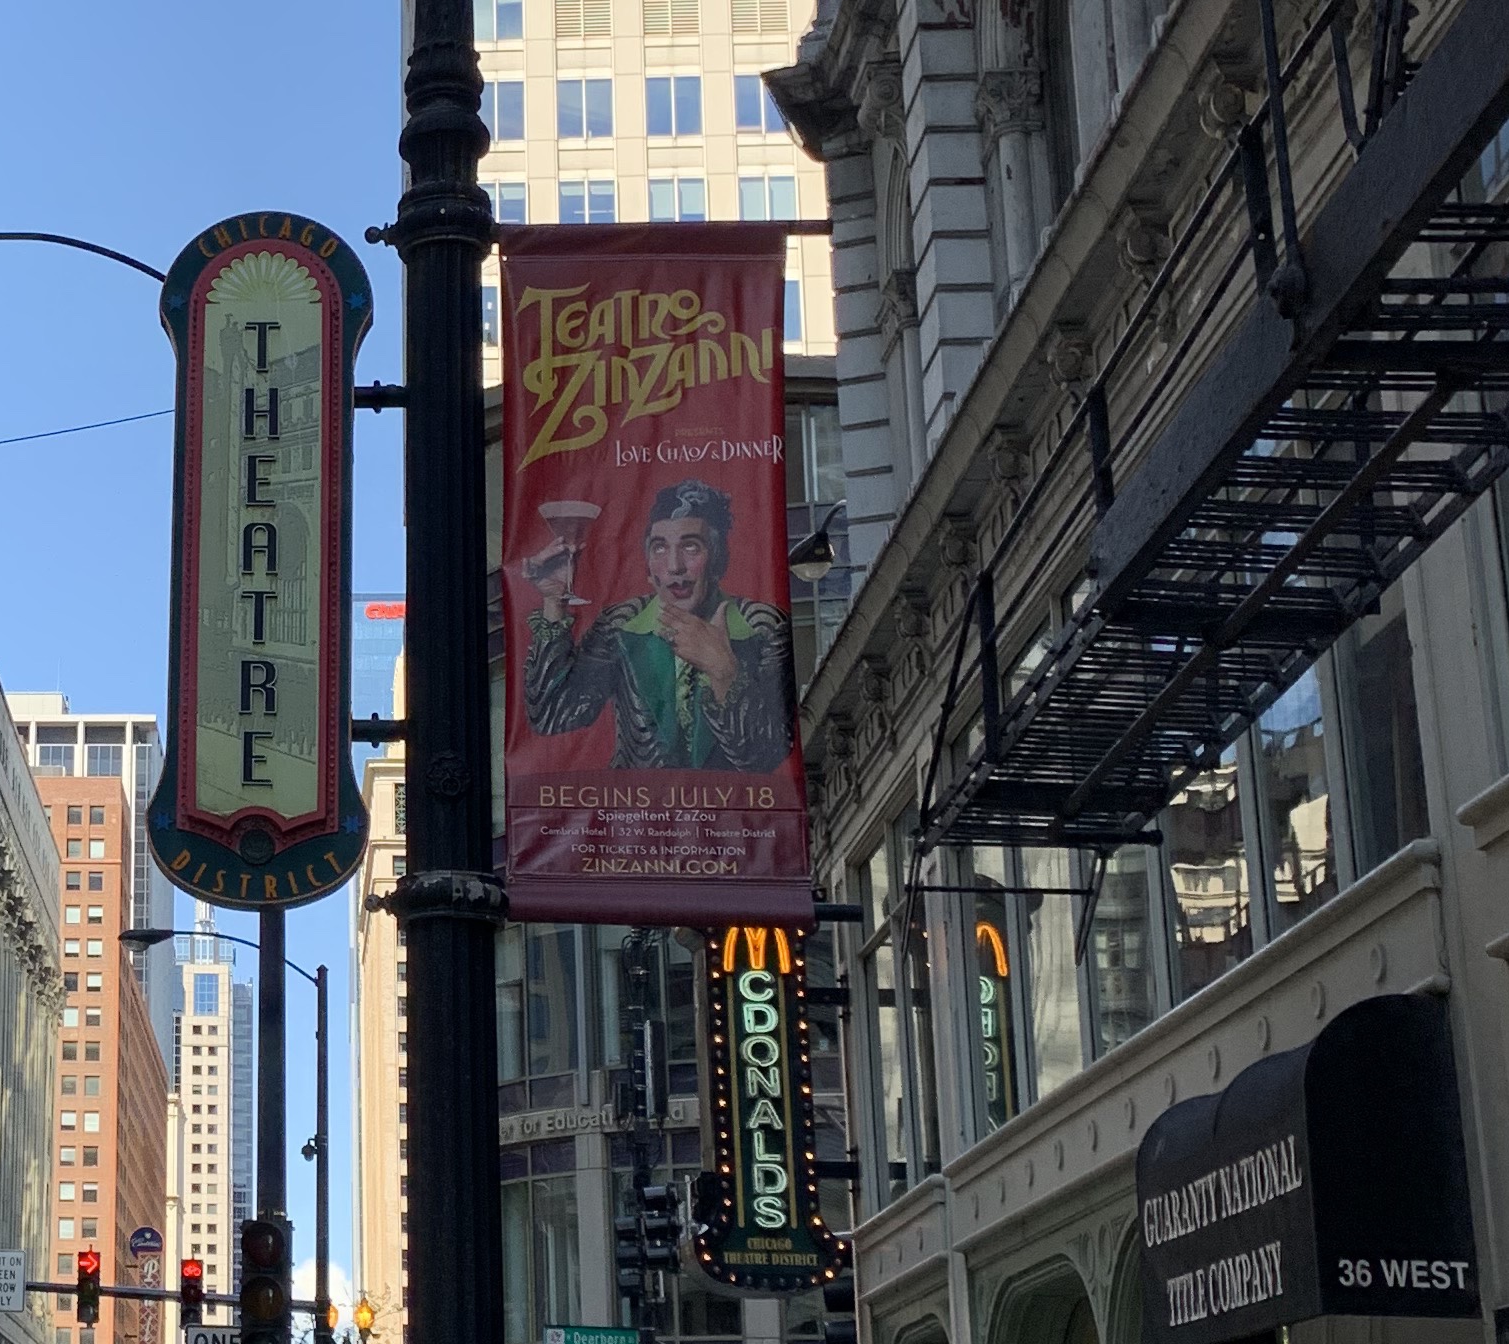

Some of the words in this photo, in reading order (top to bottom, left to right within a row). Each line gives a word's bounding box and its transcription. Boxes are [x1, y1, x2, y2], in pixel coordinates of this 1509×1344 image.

[198, 215, 338, 258] CHICAGO
[516, 281, 727, 401] TEATRO
[516, 327, 774, 474] ZINZANNI
[722, 434, 783, 465] DINNER
[238, 321, 281, 788] THEATRE
[539, 786, 651, 808] BEGINS
[662, 786, 734, 808] JULY
[746, 786, 775, 808] 18
[597, 809, 671, 824] Spiegeltent
[674, 810, 716, 822] ZaZou
[540, 826, 579, 836] Cambria
[581, 826, 607, 836] Hotel
[618, 826, 631, 837] 32
[647, 826, 692, 839] Randolph
[704, 828, 740, 838] Theatre
[742, 828, 776, 838] District
[571, 844, 596, 854] FOR
[600, 845, 647, 855] TICKETS
[650, 845, 659, 855] &
[660, 845, 746, 856] INFORMATION
[169, 849, 343, 899] DISTRICT
[581, 858, 738, 875] ZINZANNI.COM
[544, 1109, 633, 1133] Educati
[1143, 1170, 1218, 1248] GUARANTY
[1218, 1133, 1303, 1220] NATIONAL
[747, 1237, 792, 1251] CHICAGO
[9, 1256, 22, 1266] ON
[723, 1251, 770, 1265] THEATRE
[771, 1253, 818, 1267] DISTRICT
[1166, 1268, 1208, 1327] TITLE
[1208, 1241, 1283, 1316] COMPANY
[1338, 1258, 1372, 1288] 36
[1379, 1259, 1469, 1289] WEST
